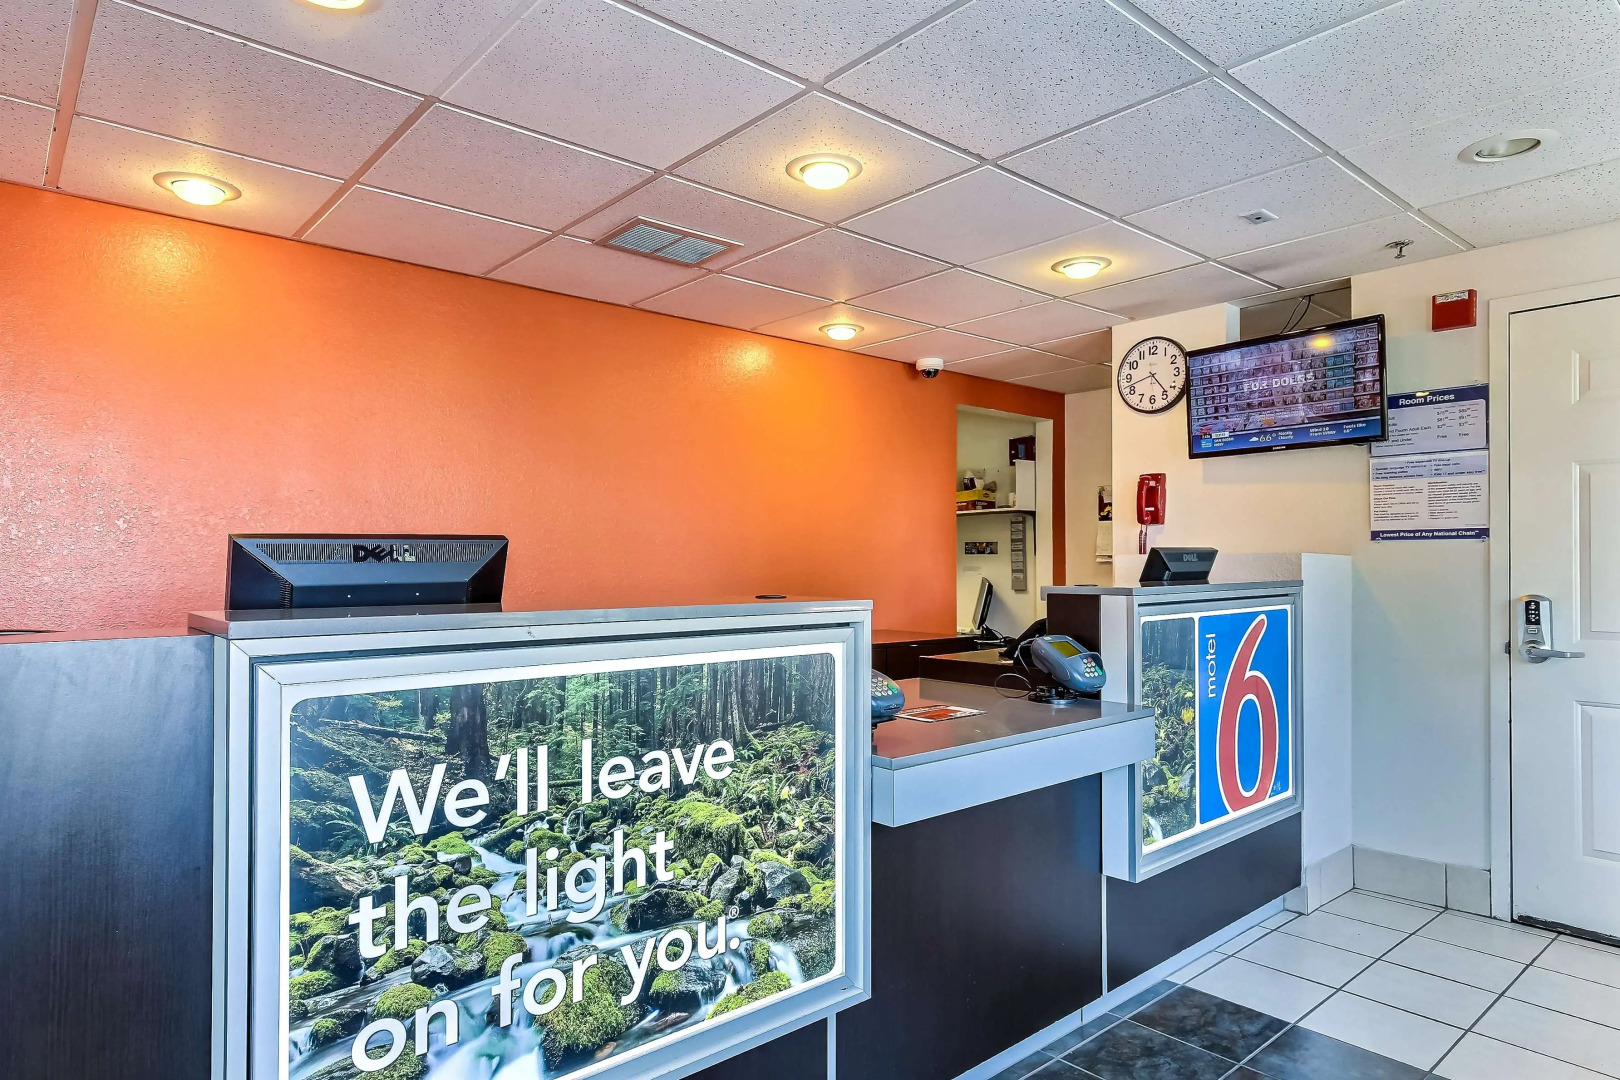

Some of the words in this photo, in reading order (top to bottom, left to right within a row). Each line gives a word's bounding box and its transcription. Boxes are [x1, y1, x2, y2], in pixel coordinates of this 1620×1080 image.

[1139, 351, 1145, 360] 11
[1148, 345, 1158, 356] 12
[1164, 347, 1167, 356] 1
[1170, 354, 1177, 364] 2
[1129, 360, 1138, 370] 10
[1174, 367, 1180, 376] 3
[1125, 374, 1132, 383] 9
[1170, 380, 1176, 390] 4
[1129, 386, 1136, 395] 8
[1162, 391, 1169, 400] 5
[1138, 394, 1145, 403] 7
[1149, 394, 1156, 404] 6
[1399, 398, 1424, 406] Room
[1427, 394, 1455, 402] Prices
[353, 544, 416, 562] DELL
[1183, 553, 1198, 562] DELL
[1206, 633, 1217, 698] motel
[1216, 613, 1279, 815] 6
[348, 744, 549, 844] We’ll
[580, 738, 735, 804] leave
[348, 874, 492, 960] the
[525, 830, 677, 925] light
[351, 1000, 461, 1073] on
[491, 952, 598, 1028] for
